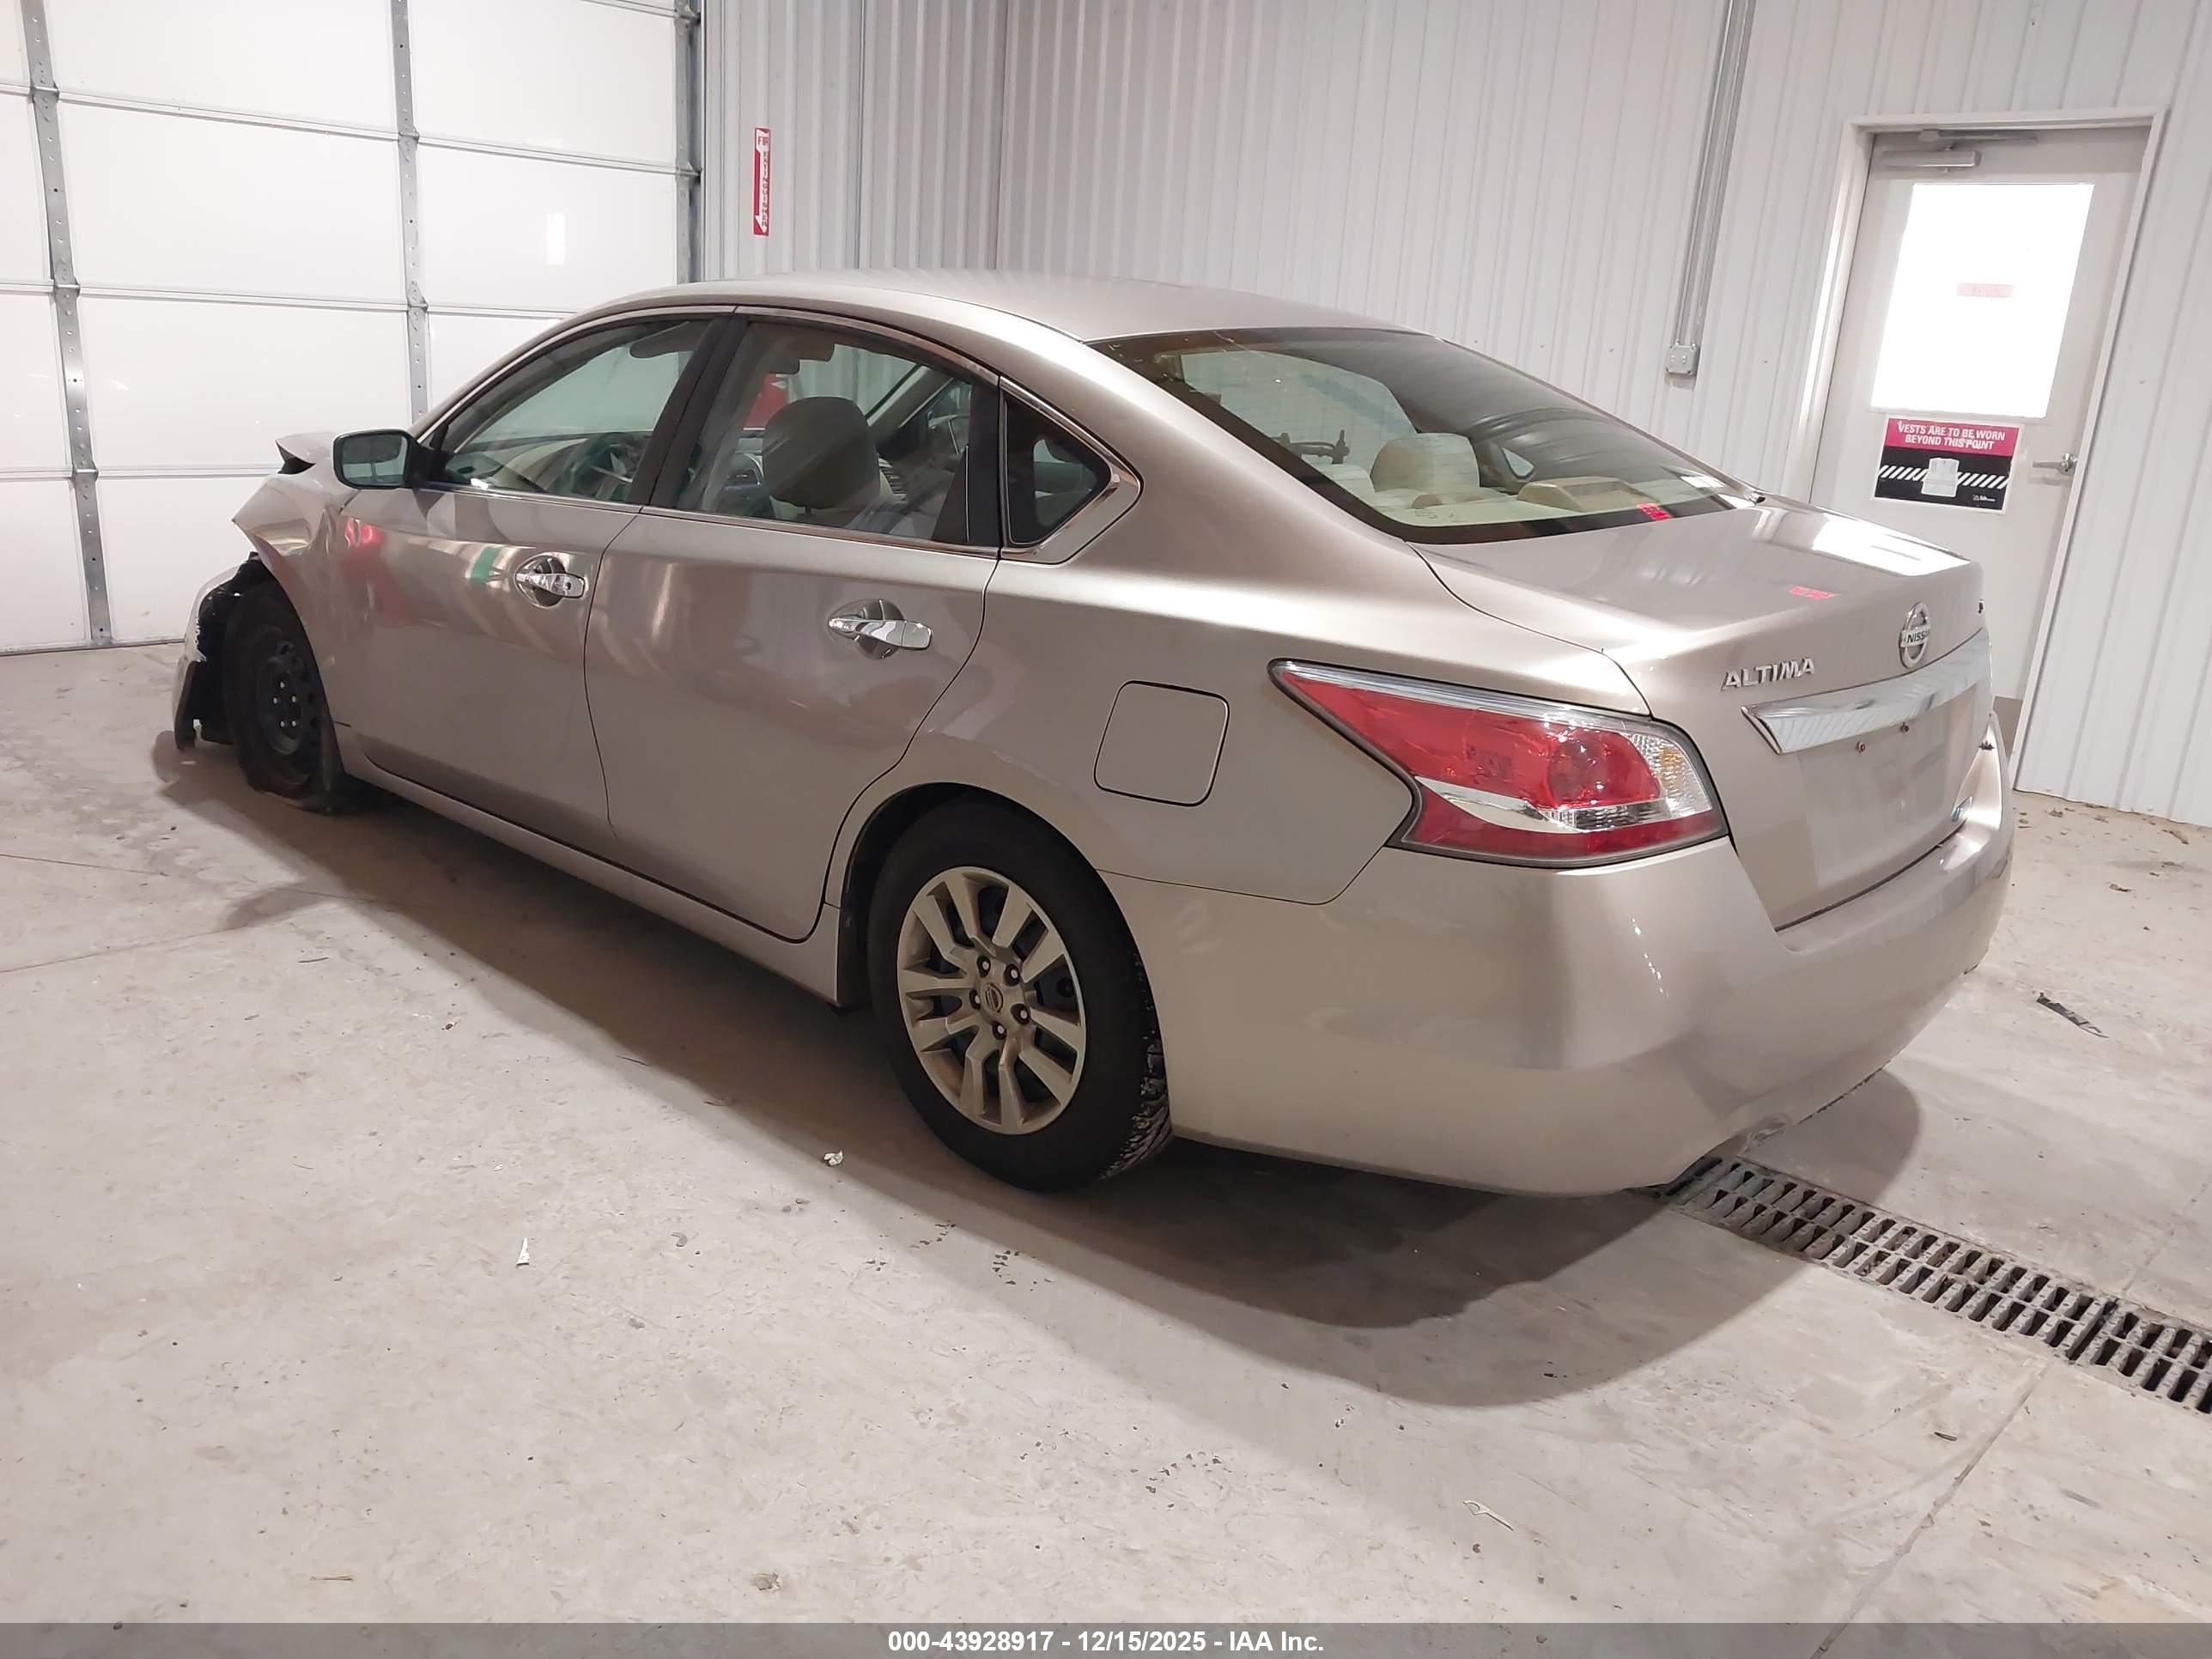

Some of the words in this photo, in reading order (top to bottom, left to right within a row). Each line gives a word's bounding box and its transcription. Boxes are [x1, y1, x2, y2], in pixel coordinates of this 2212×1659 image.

[1898, 421, 1926, 434] VESTS
[1927, 425, 1946, 436] ARE
[1948, 427, 1960, 437] TO
[1961, 428, 1975, 439] BE
[1976, 429, 2005, 441] WORN
[1905, 434, 1942, 446] BEYOND
[1944, 437, 1964, 447] THIS
[1965, 439, 1995, 450] POINT
[1720, 658, 1815, 690] ALTIMA
